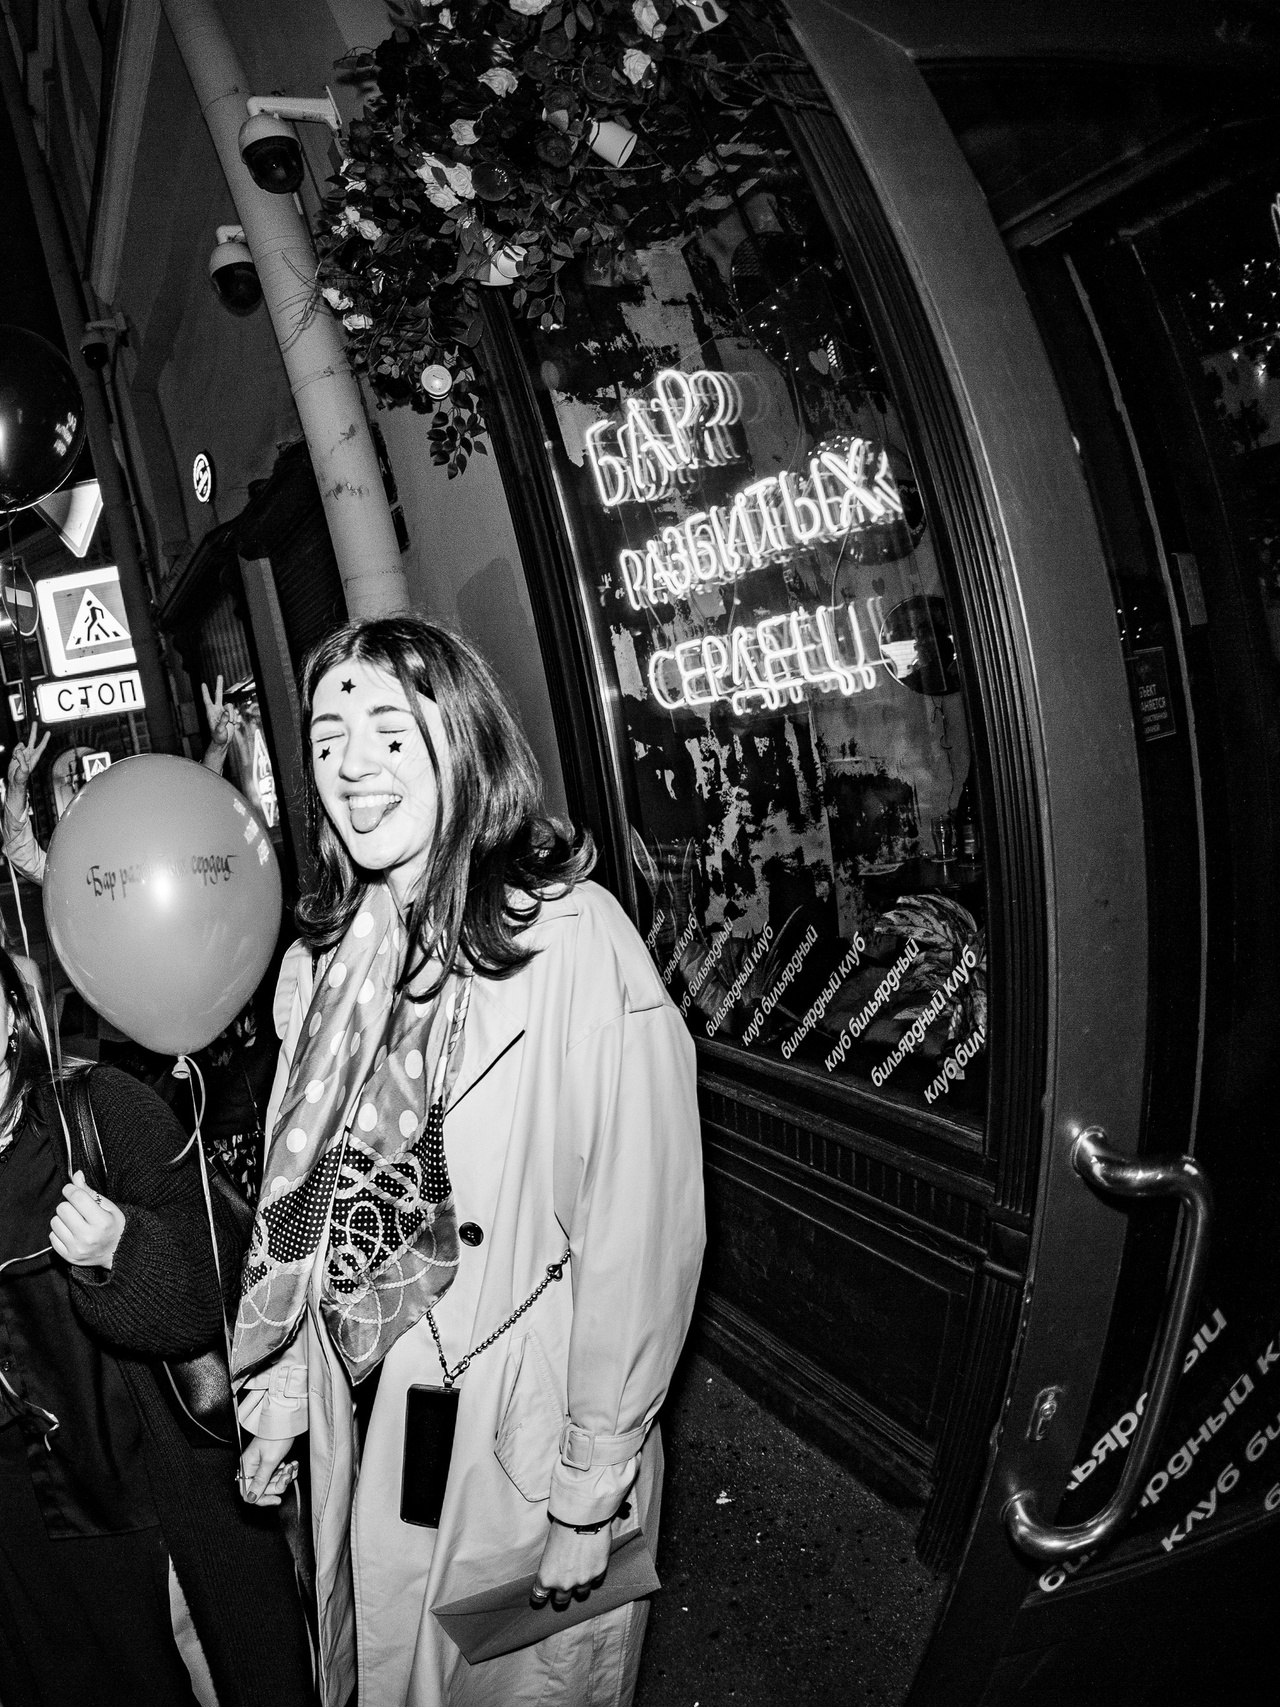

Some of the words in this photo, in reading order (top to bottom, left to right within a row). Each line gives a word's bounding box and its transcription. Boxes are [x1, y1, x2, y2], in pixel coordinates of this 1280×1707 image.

[585, 368, 700, 507] БАР
[619, 437, 888, 611] РАЗБИТЫХ
[57, 679, 137, 712] СТОП
[648, 602, 872, 716] СЕРДЕЦ
[86, 865, 116, 901] Бар
[678, 913, 698, 951] клуб
[688, 916, 734, 998] бильярдный
[705, 956, 755, 1037] бильярдный
[751, 921, 774, 964] клуб
[742, 1008, 764, 1047] клуб
[761, 924, 819, 1015] бильярдный
[781, 971, 842, 1060] бильярдный
[838, 931, 866, 979] клуб
[824, 1029, 852, 1072] клуб
[848, 937, 920, 1038] бильярдный
[871, 989, 947, 1087] бильярдный
[943, 944, 977, 998] клуб
[923, 1057, 957, 1104] клуб
[1161, 1463, 1240, 1552] клуб
